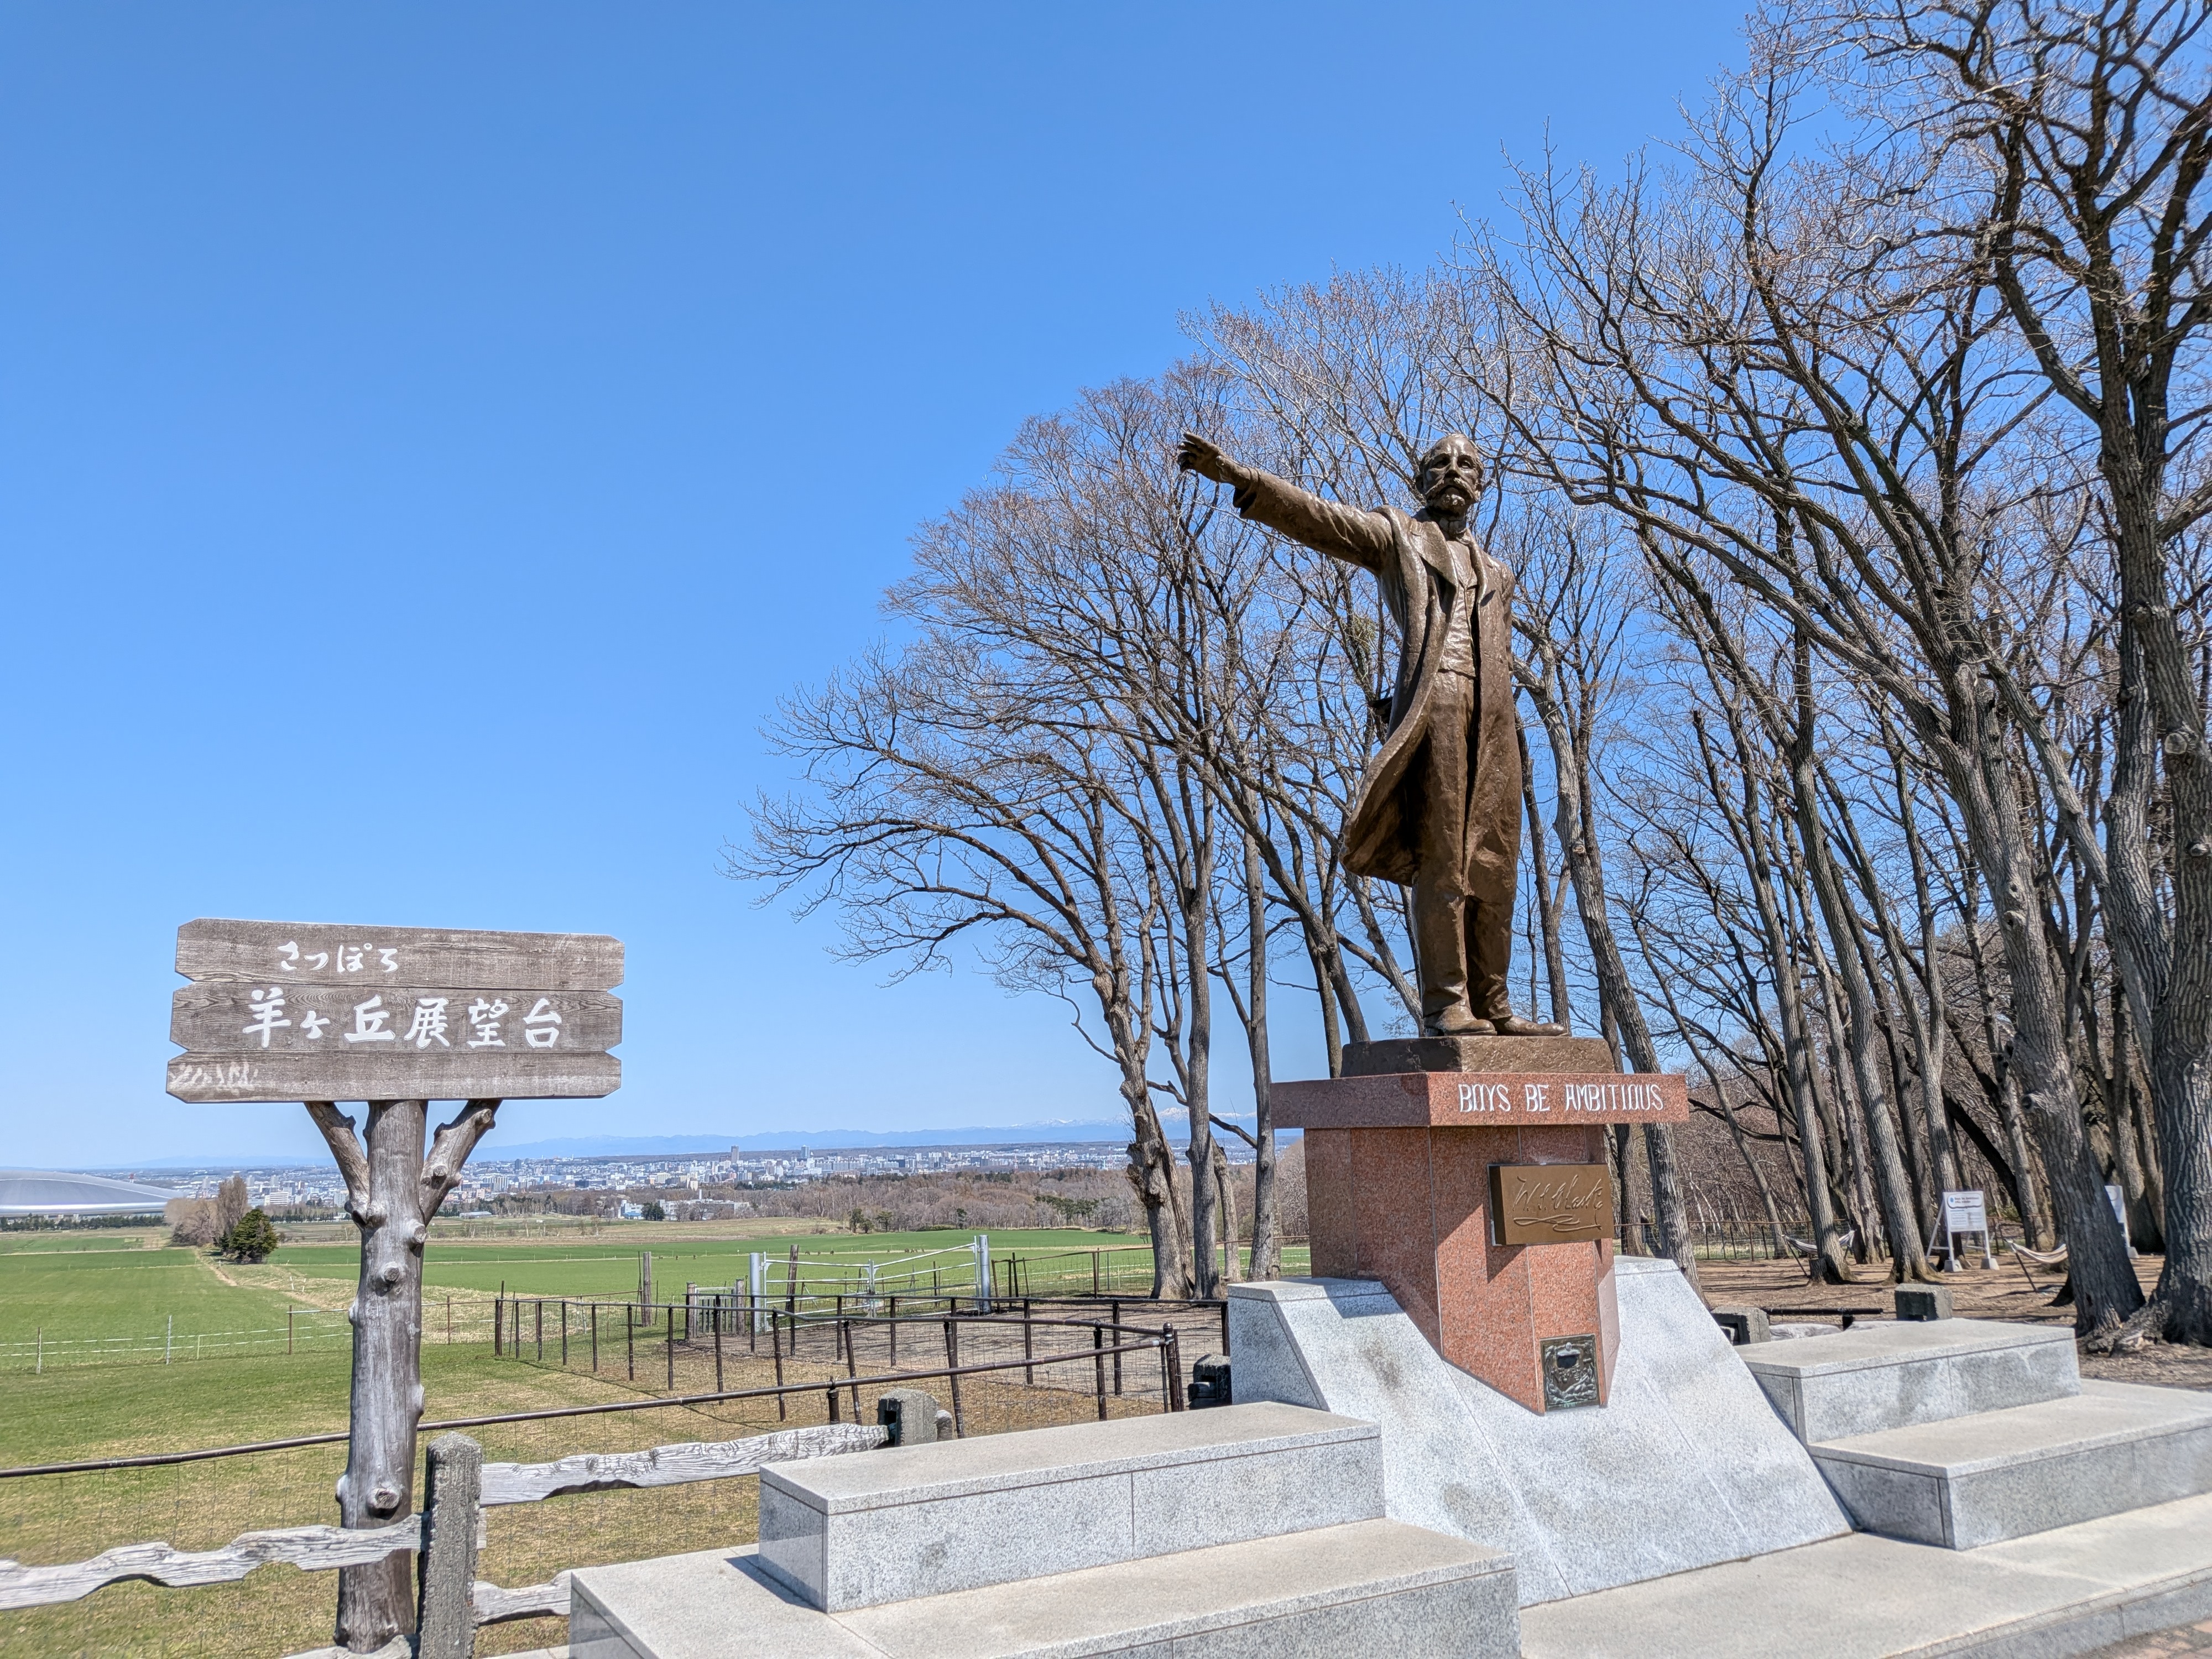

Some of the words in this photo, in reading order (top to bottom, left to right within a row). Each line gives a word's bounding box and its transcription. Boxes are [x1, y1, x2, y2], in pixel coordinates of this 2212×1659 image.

[278, 940, 399, 973] さっぽろ
[1458, 1083, 1511, 1112] BOYS
[1526, 1084, 1550, 1112] BE
[1565, 1084, 1663, 1112] AMBITIOUS
